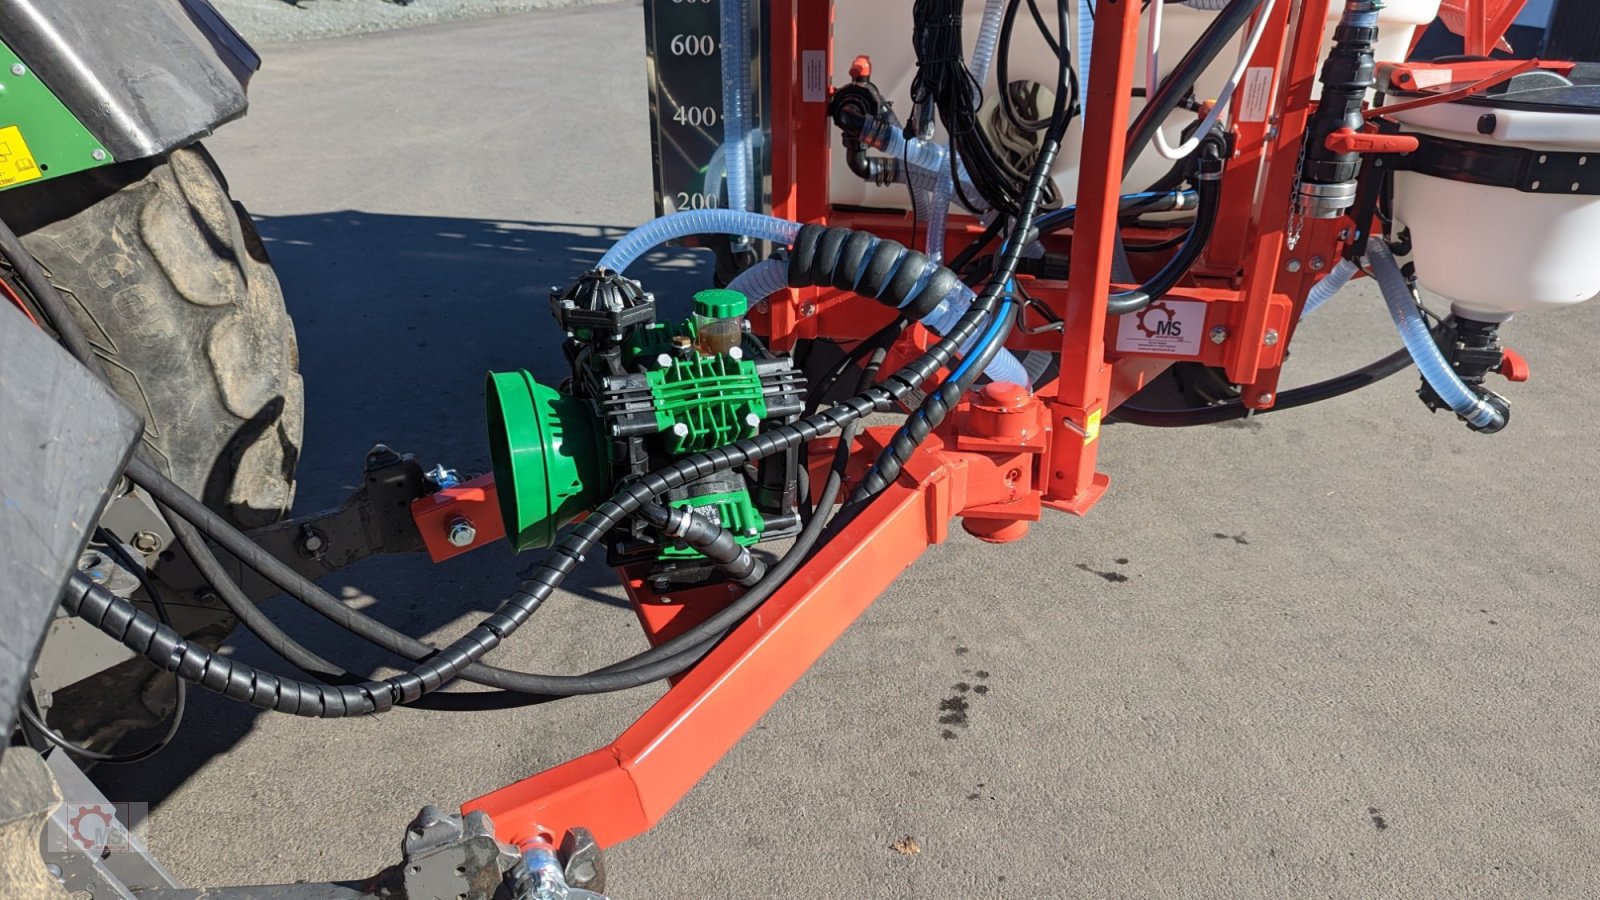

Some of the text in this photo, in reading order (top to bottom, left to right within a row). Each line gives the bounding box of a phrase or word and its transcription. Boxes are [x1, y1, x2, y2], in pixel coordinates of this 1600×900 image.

[671, 34, 714, 56] 600
[673, 105, 716, 127] 400
[677, 192, 718, 210] 200
[1156, 320, 1182, 336] MS
